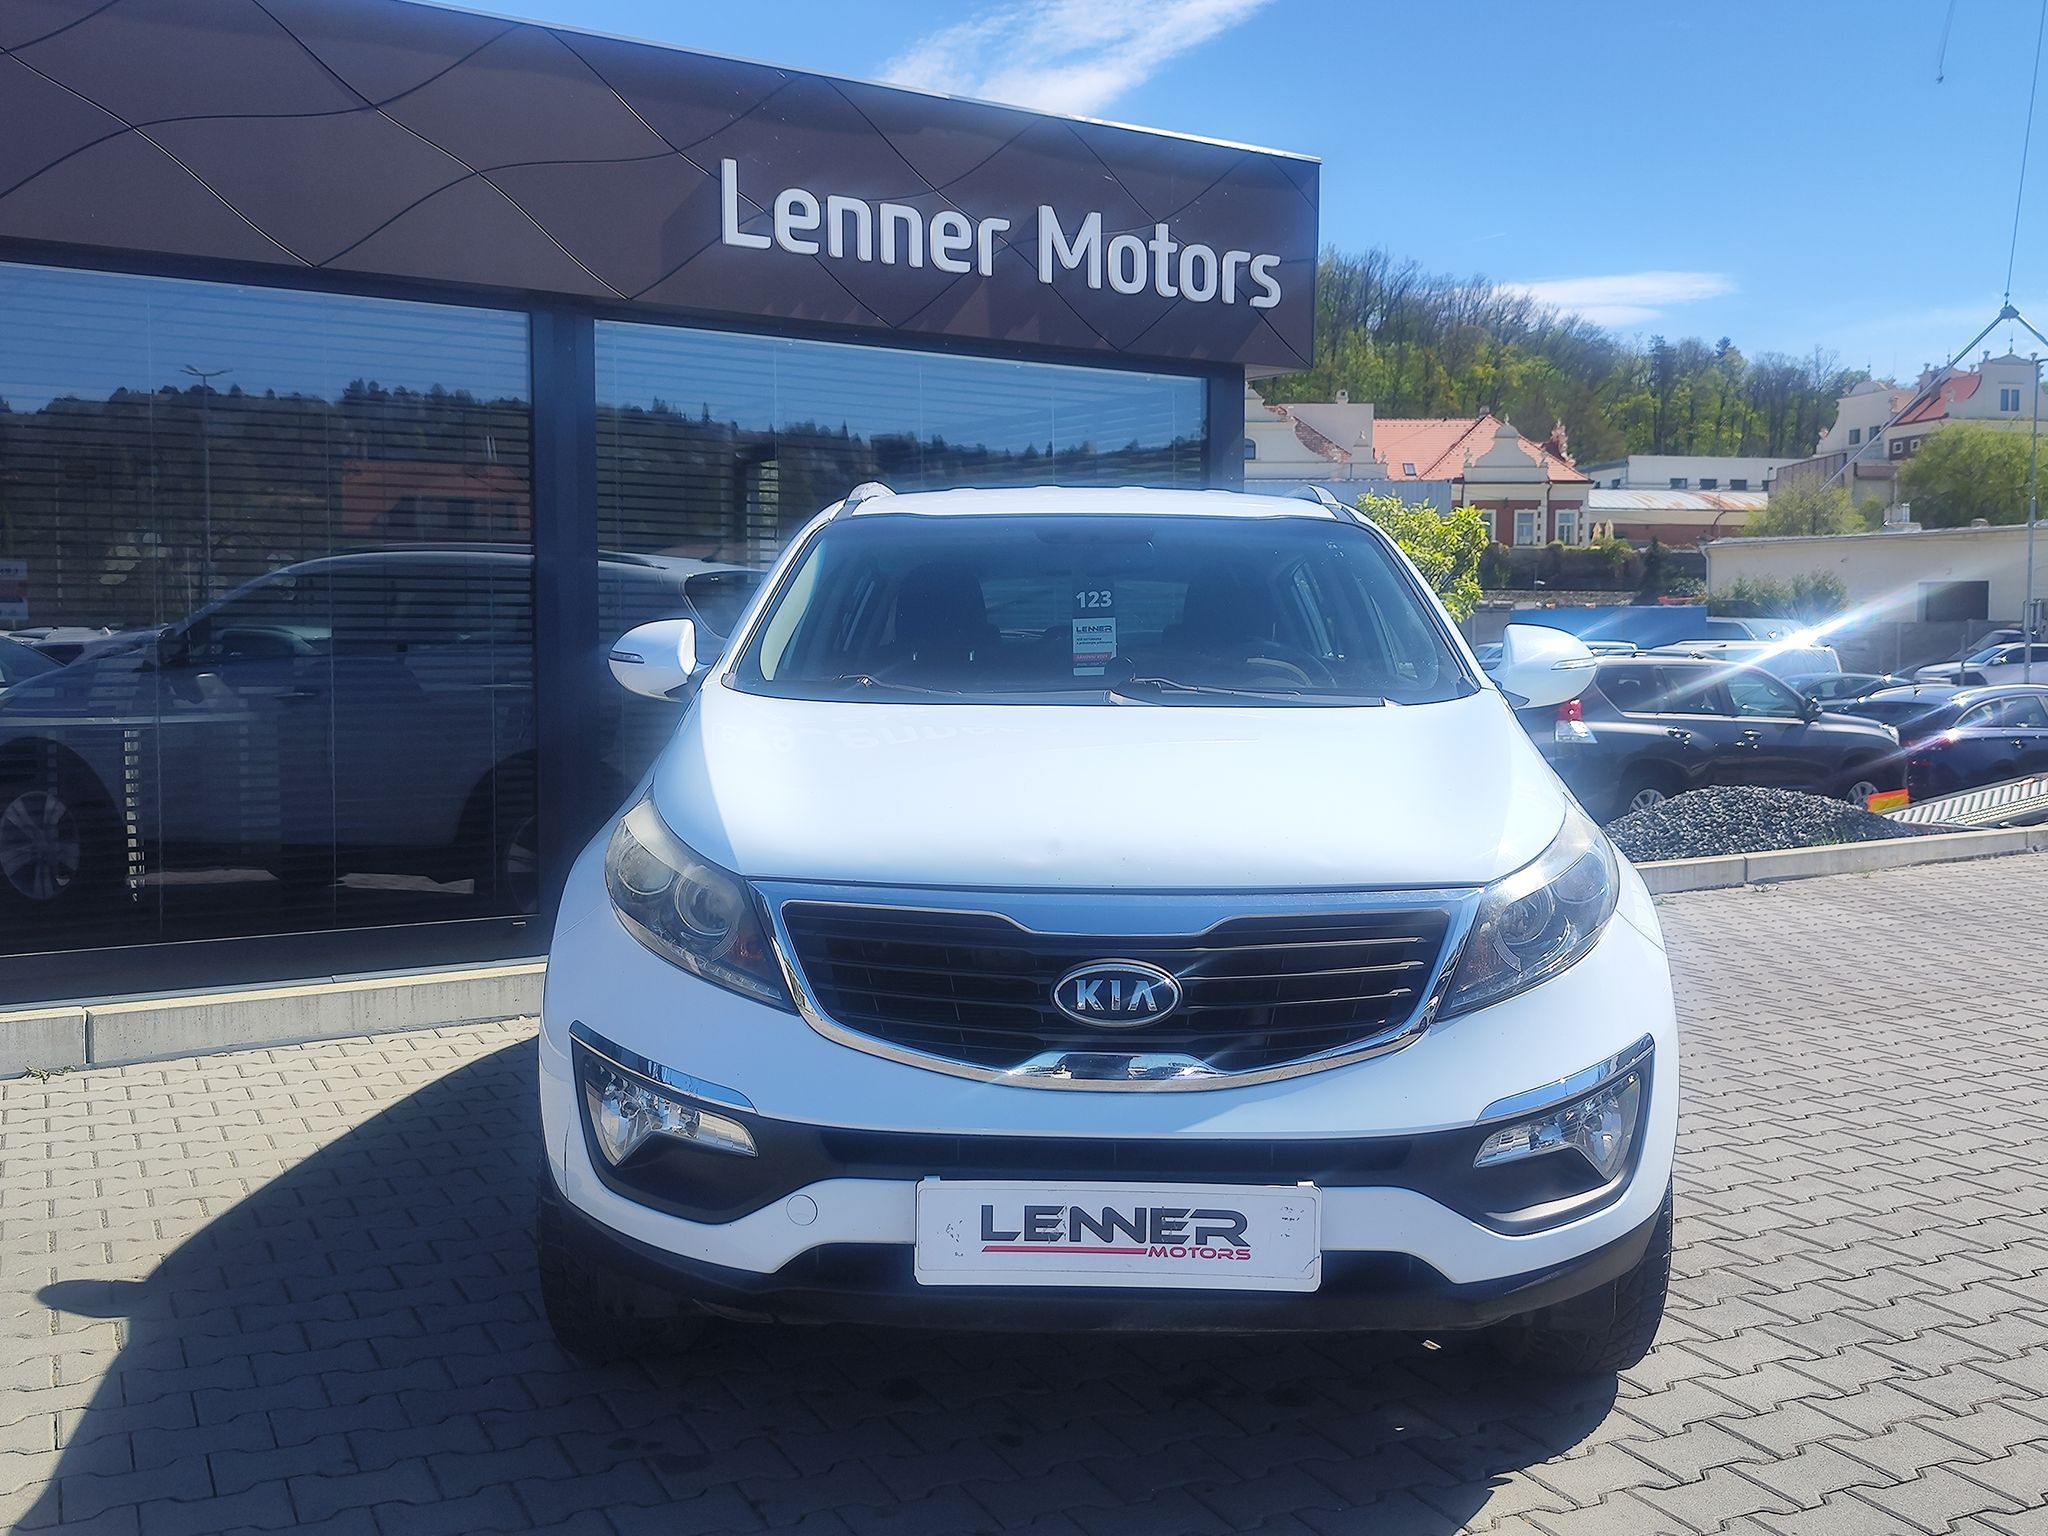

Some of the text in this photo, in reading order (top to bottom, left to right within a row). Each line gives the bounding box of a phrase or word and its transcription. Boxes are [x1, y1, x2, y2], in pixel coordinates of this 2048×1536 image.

[721, 158, 1282, 308] Lenner Motors
[1076, 591, 1112, 608] 123
[1076, 979, 1158, 1011] KIA
[980, 1204, 1251, 1247] LENNER
[1148, 1245, 1251, 1260] MOTORS
